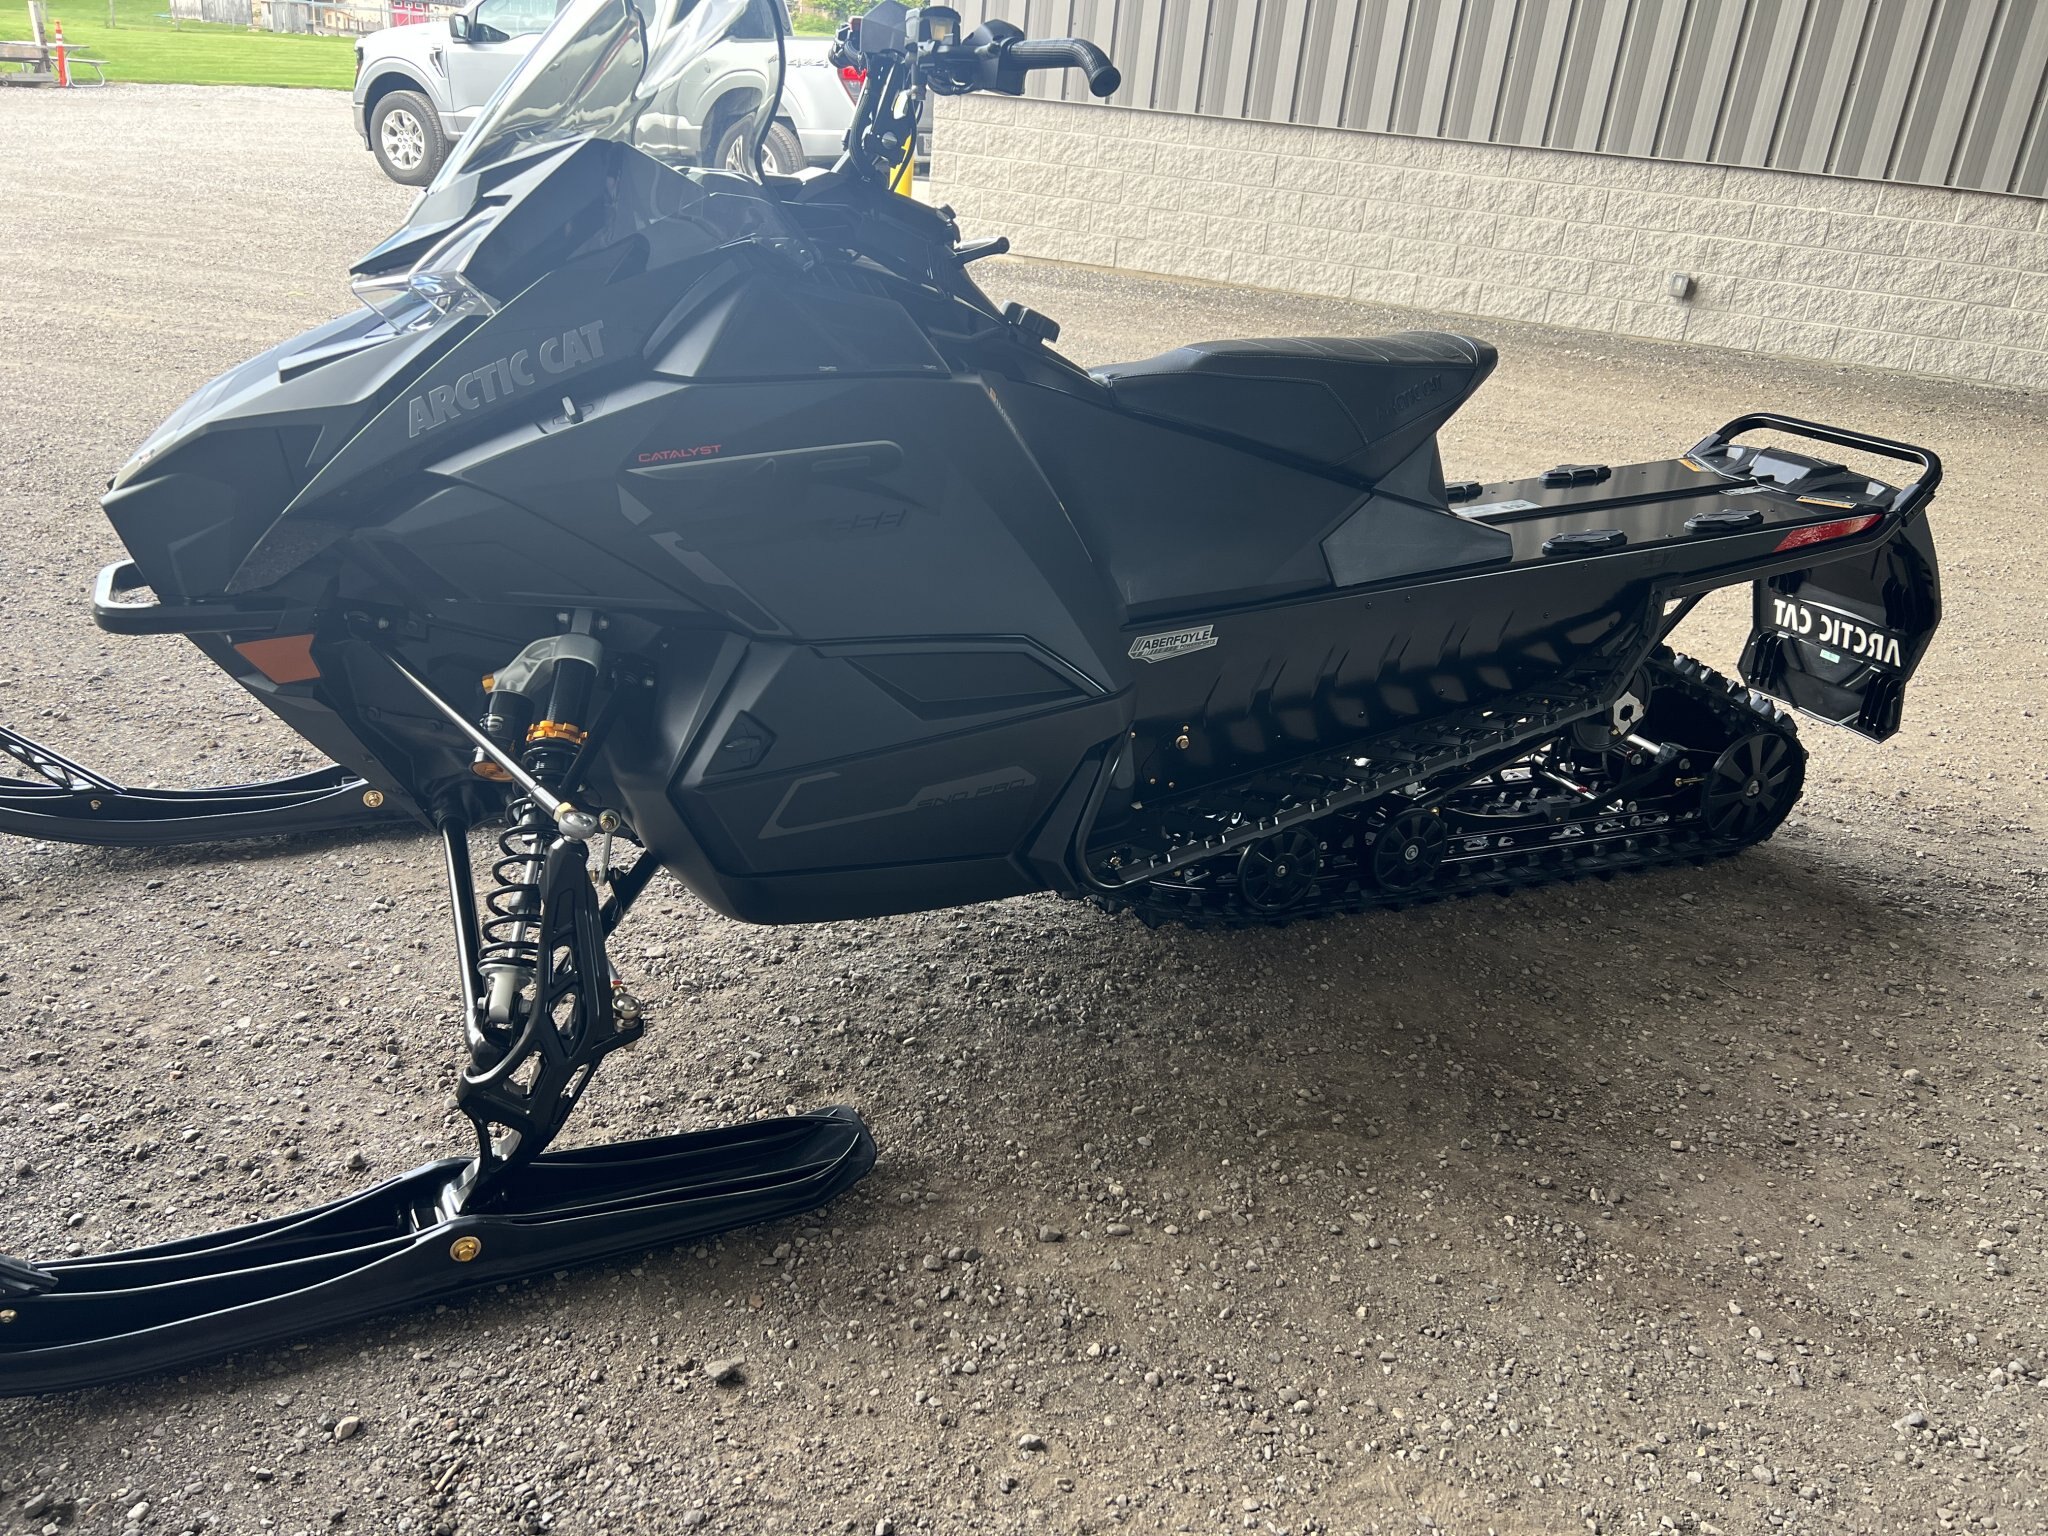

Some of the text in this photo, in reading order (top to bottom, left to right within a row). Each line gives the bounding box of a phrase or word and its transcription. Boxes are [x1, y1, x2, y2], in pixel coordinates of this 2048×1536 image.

[409, 319, 605, 439] ARCTIC CAT
[638, 444, 722, 462] CATALYST
[1141, 630, 1211, 650] ABERFOYLE
